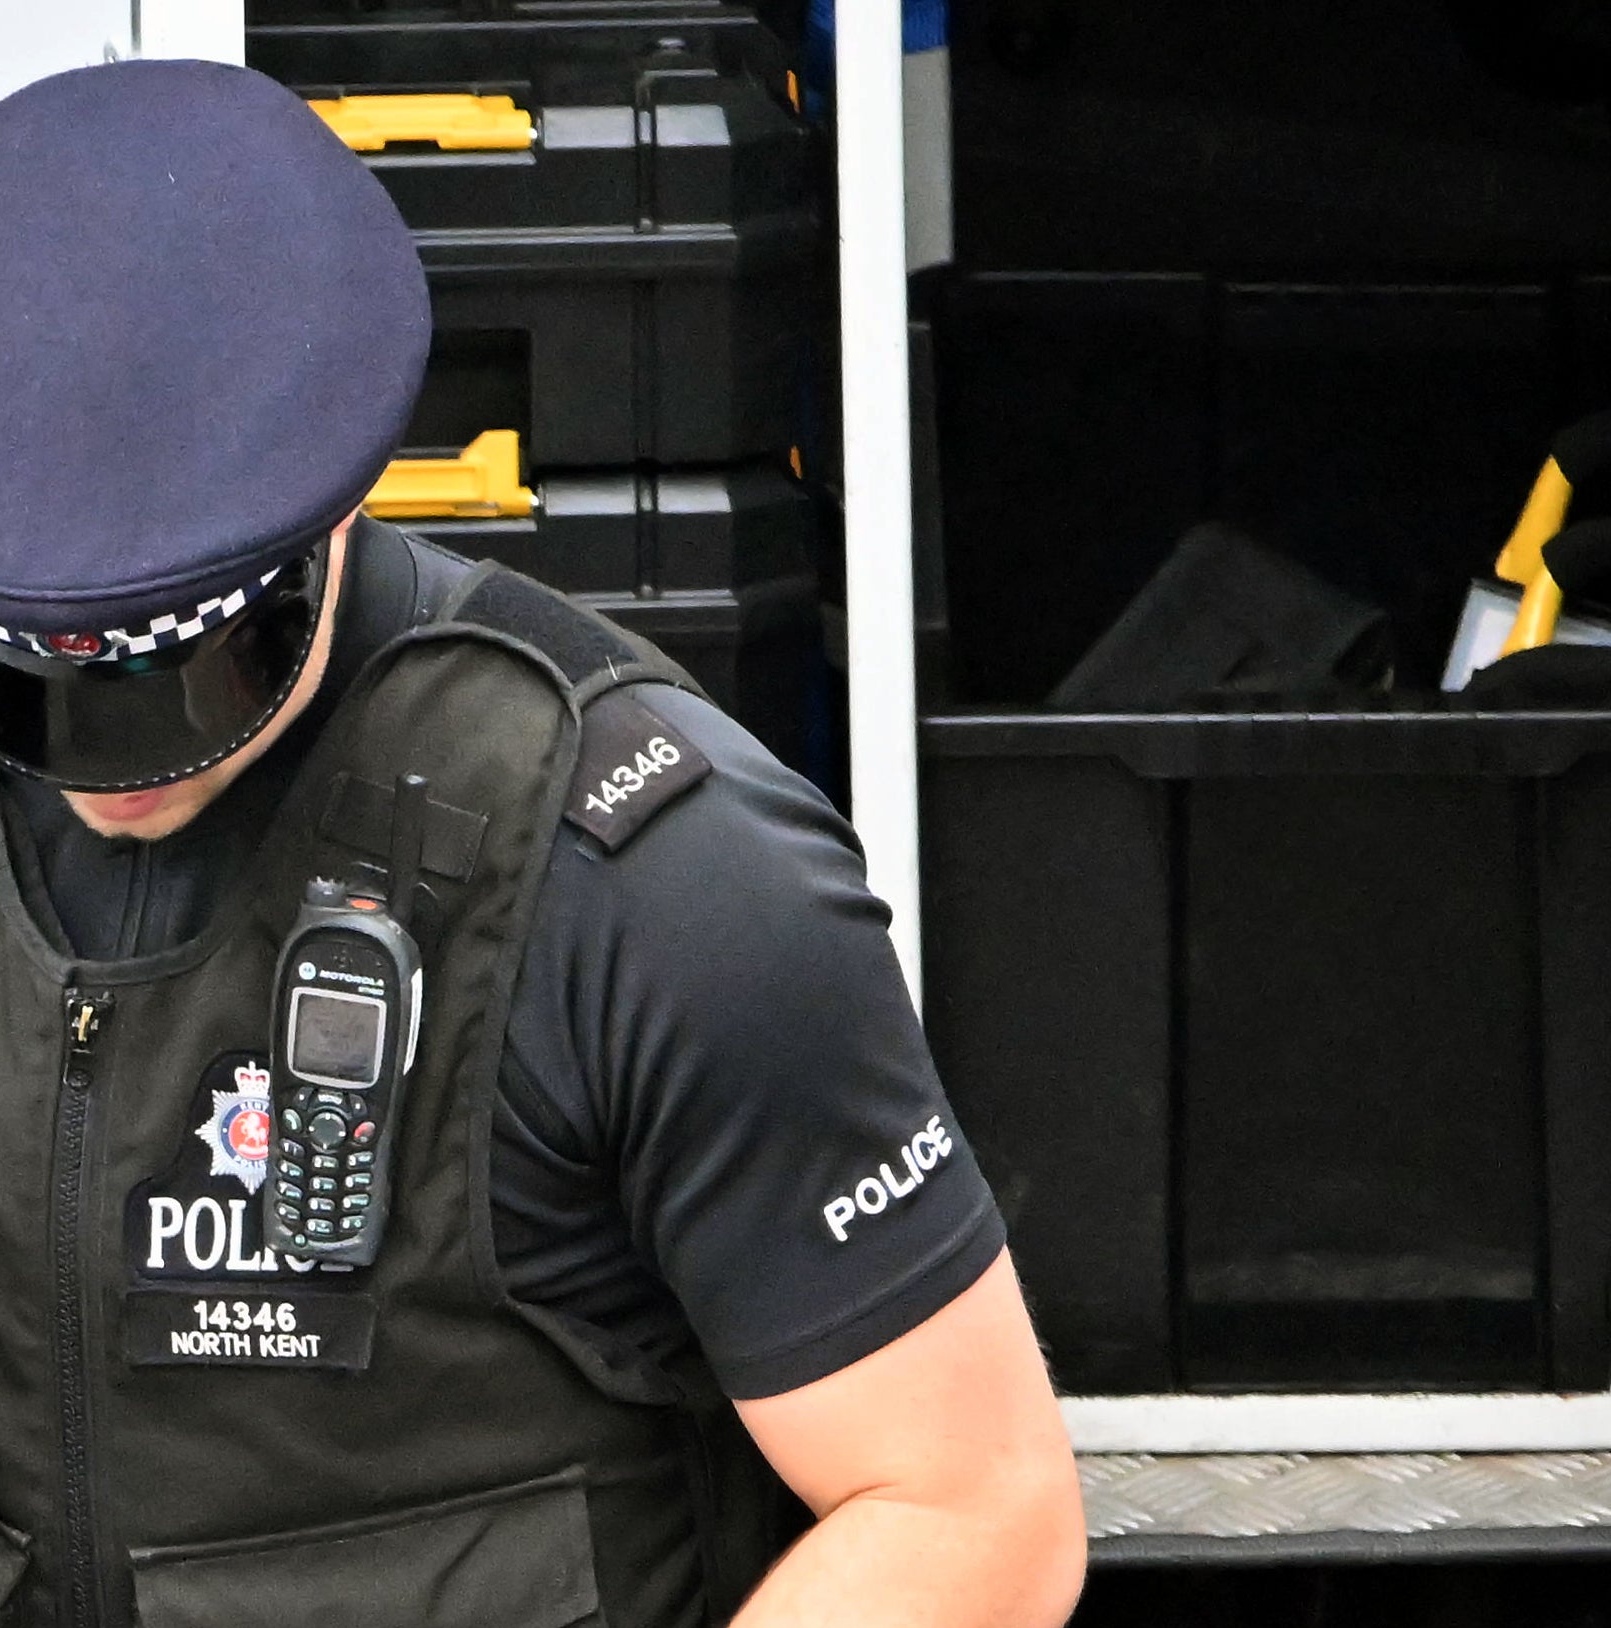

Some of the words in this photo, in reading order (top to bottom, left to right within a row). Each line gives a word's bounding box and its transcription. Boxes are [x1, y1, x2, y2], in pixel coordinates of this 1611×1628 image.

[585, 736, 681, 814] 14346
[823, 1114, 953, 1242] POLICE
[146, 1196, 355, 1273] POL
[171, 1331, 252, 1357] NORTH
[259, 1334, 321, 1358] KENT
[192, 1300, 297, 1332] 14346
